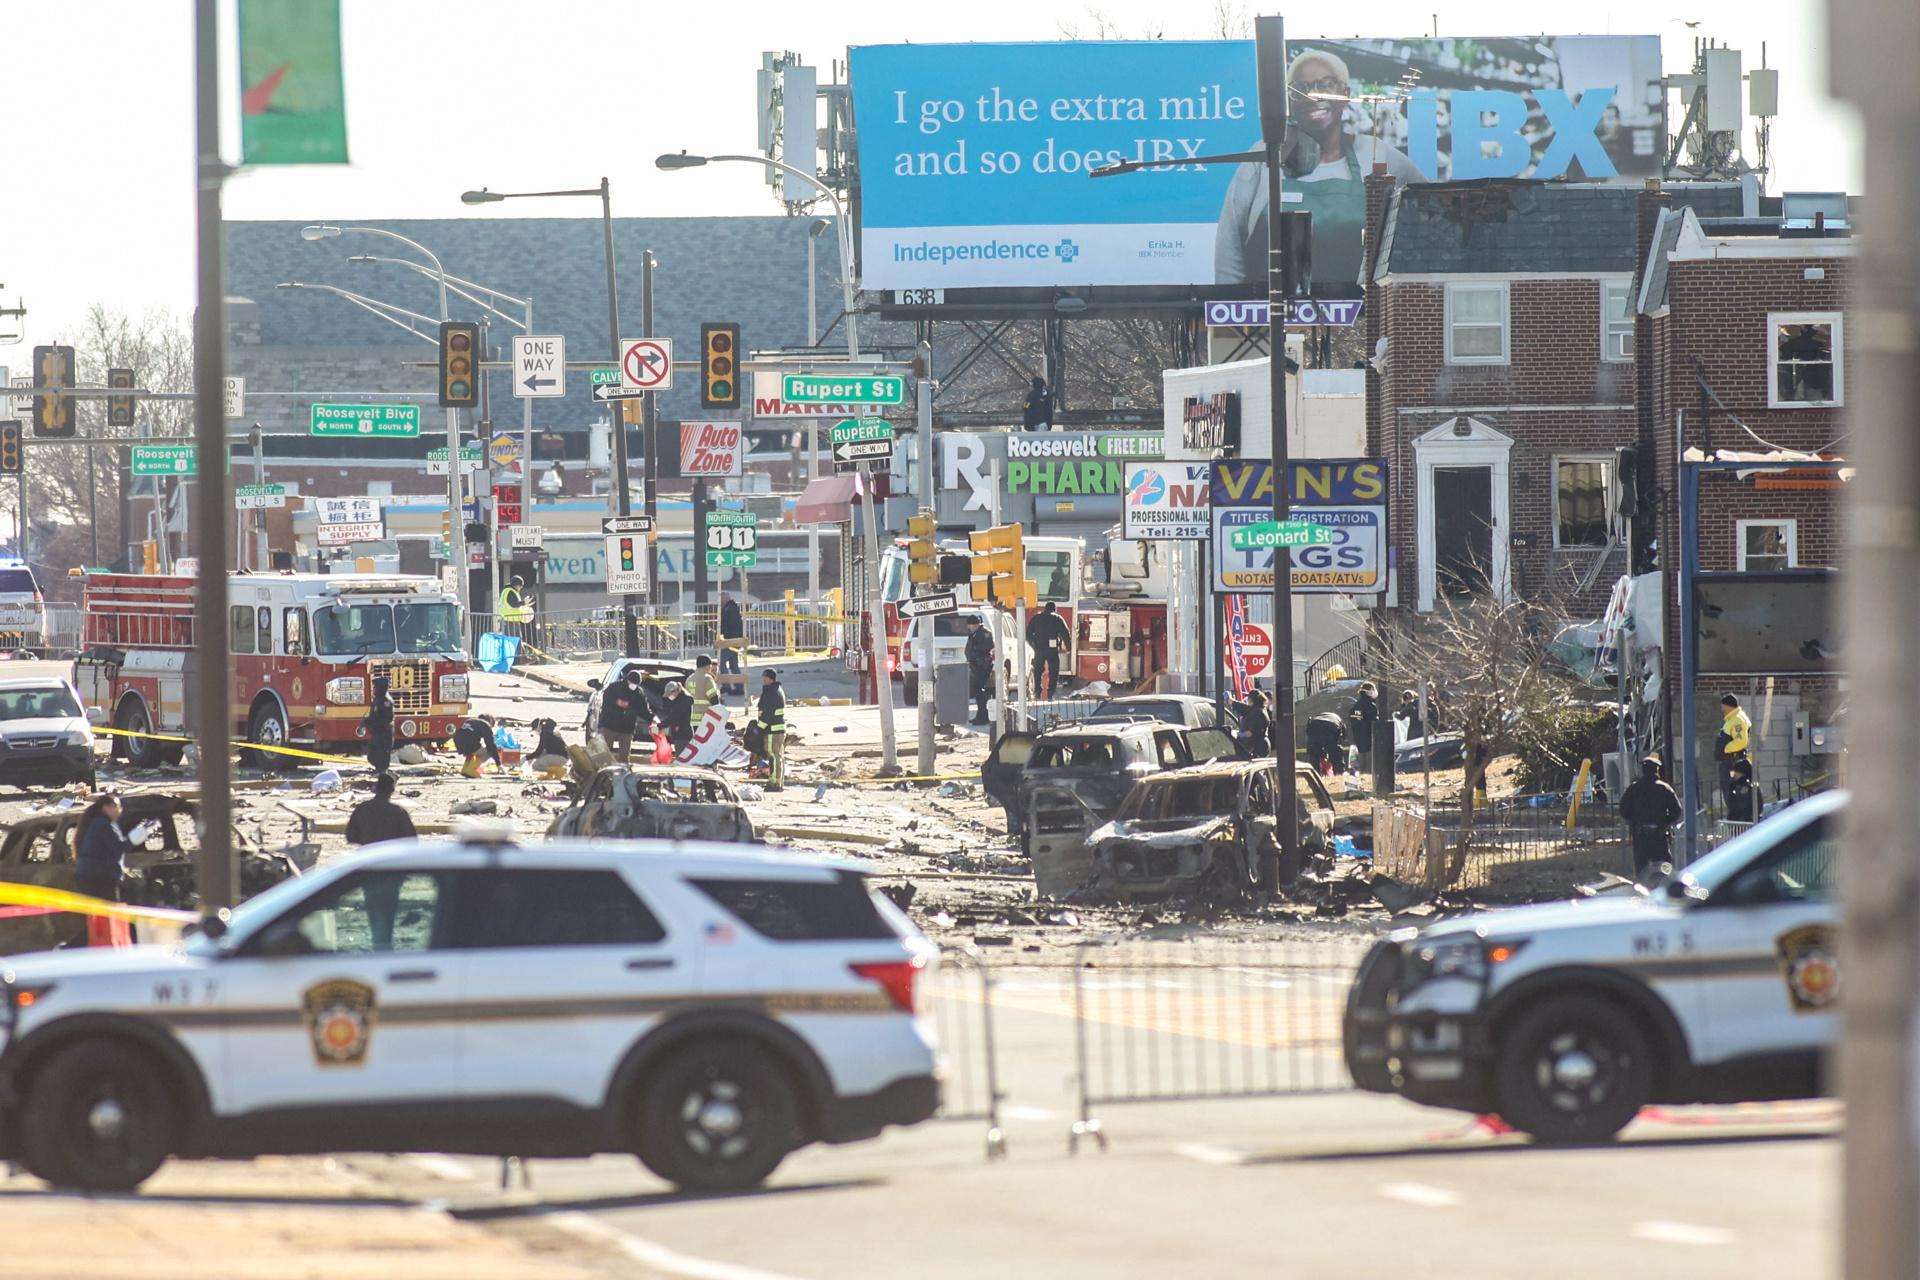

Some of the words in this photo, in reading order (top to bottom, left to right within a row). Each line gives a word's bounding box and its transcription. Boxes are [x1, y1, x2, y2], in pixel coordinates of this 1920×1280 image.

[894, 90, 907, 124] I
[919, 98, 965, 135] go
[976, 87, 1038, 123] the
[1050, 93, 1148, 122] extra
[1158, 85, 1245, 121] mile
[1406, 87, 1620, 180] IBX
[894, 140, 968, 177] and
[980, 149, 1021, 174] so
[1032, 138, 1120, 173] does
[1134, 139, 1207, 172] IBX
[1148, 239, 1173, 249] Erika
[1175, 240, 1185, 249] H.
[894, 240, 1049, 265] Independence
[903, 289, 935, 305] 638
[1210, 303, 1354, 323] OUTONT
[523, 342, 554, 355] ONE
[523, 358, 554, 371] WAY
[792, 380, 862, 399] Rupert
[872, 381, 894, 397] St
[756, 398, 876, 414] MARK
[316, 408, 380, 419] Roosevelt
[385, 408, 414, 419] Blvd
[698, 424, 738, 450] Auto
[834, 426, 880, 442] RUPERT
[882, 428, 891, 437] ST
[491, 444, 524, 457] UNOCO
[851, 446, 867, 454] ONE
[870, 443, 887, 453] WAY
[1008, 435, 1098, 457] Roosevelt
[1107, 437, 1136, 455] FREE
[137, 449, 194, 459] Roosevelt
[427, 452, 469, 461] ROOSELT
[689, 449, 734, 474] Zone
[433, 464, 440, 472] N
[1218, 464, 1383, 500] VAN'S
[236, 487, 272, 496] ROOSEVELT
[241, 498, 247, 506] N
[273, 497, 279, 505] S
[708, 514, 731, 523] NORTH
[732, 515, 754, 523] SOUTH
[1131, 511, 1190, 523] PROFESSIONAL
[1231, 513, 1269, 524] TITLES
[1288, 513, 1369, 524] EGISTRATION
[320, 524, 380, 533] INTEGRITY
[616, 521, 630, 529] ONE
[633, 520, 647, 529] WAY
[716, 530, 722, 545] 1
[738, 531, 745, 546] 1
[1147, 527, 1171, 537] Tel:
[1248, 528, 1309, 545] Leonard
[1315, 529, 1330, 542] St
[516, 538, 536, 546] MUST
[616, 573, 641, 581] PHOTO
[1236, 574, 1275, 584] NOTAR
[1292, 573, 1364, 584] BOATS/ATVs
[610, 583, 648, 591] ENFORCED
[915, 602, 930, 611] ONE
[933, 599, 950, 609] WAY
[1252, 657, 1265, 666] DO
[390, 666, 415, 689] 18
[419, 721, 430, 734] 18
